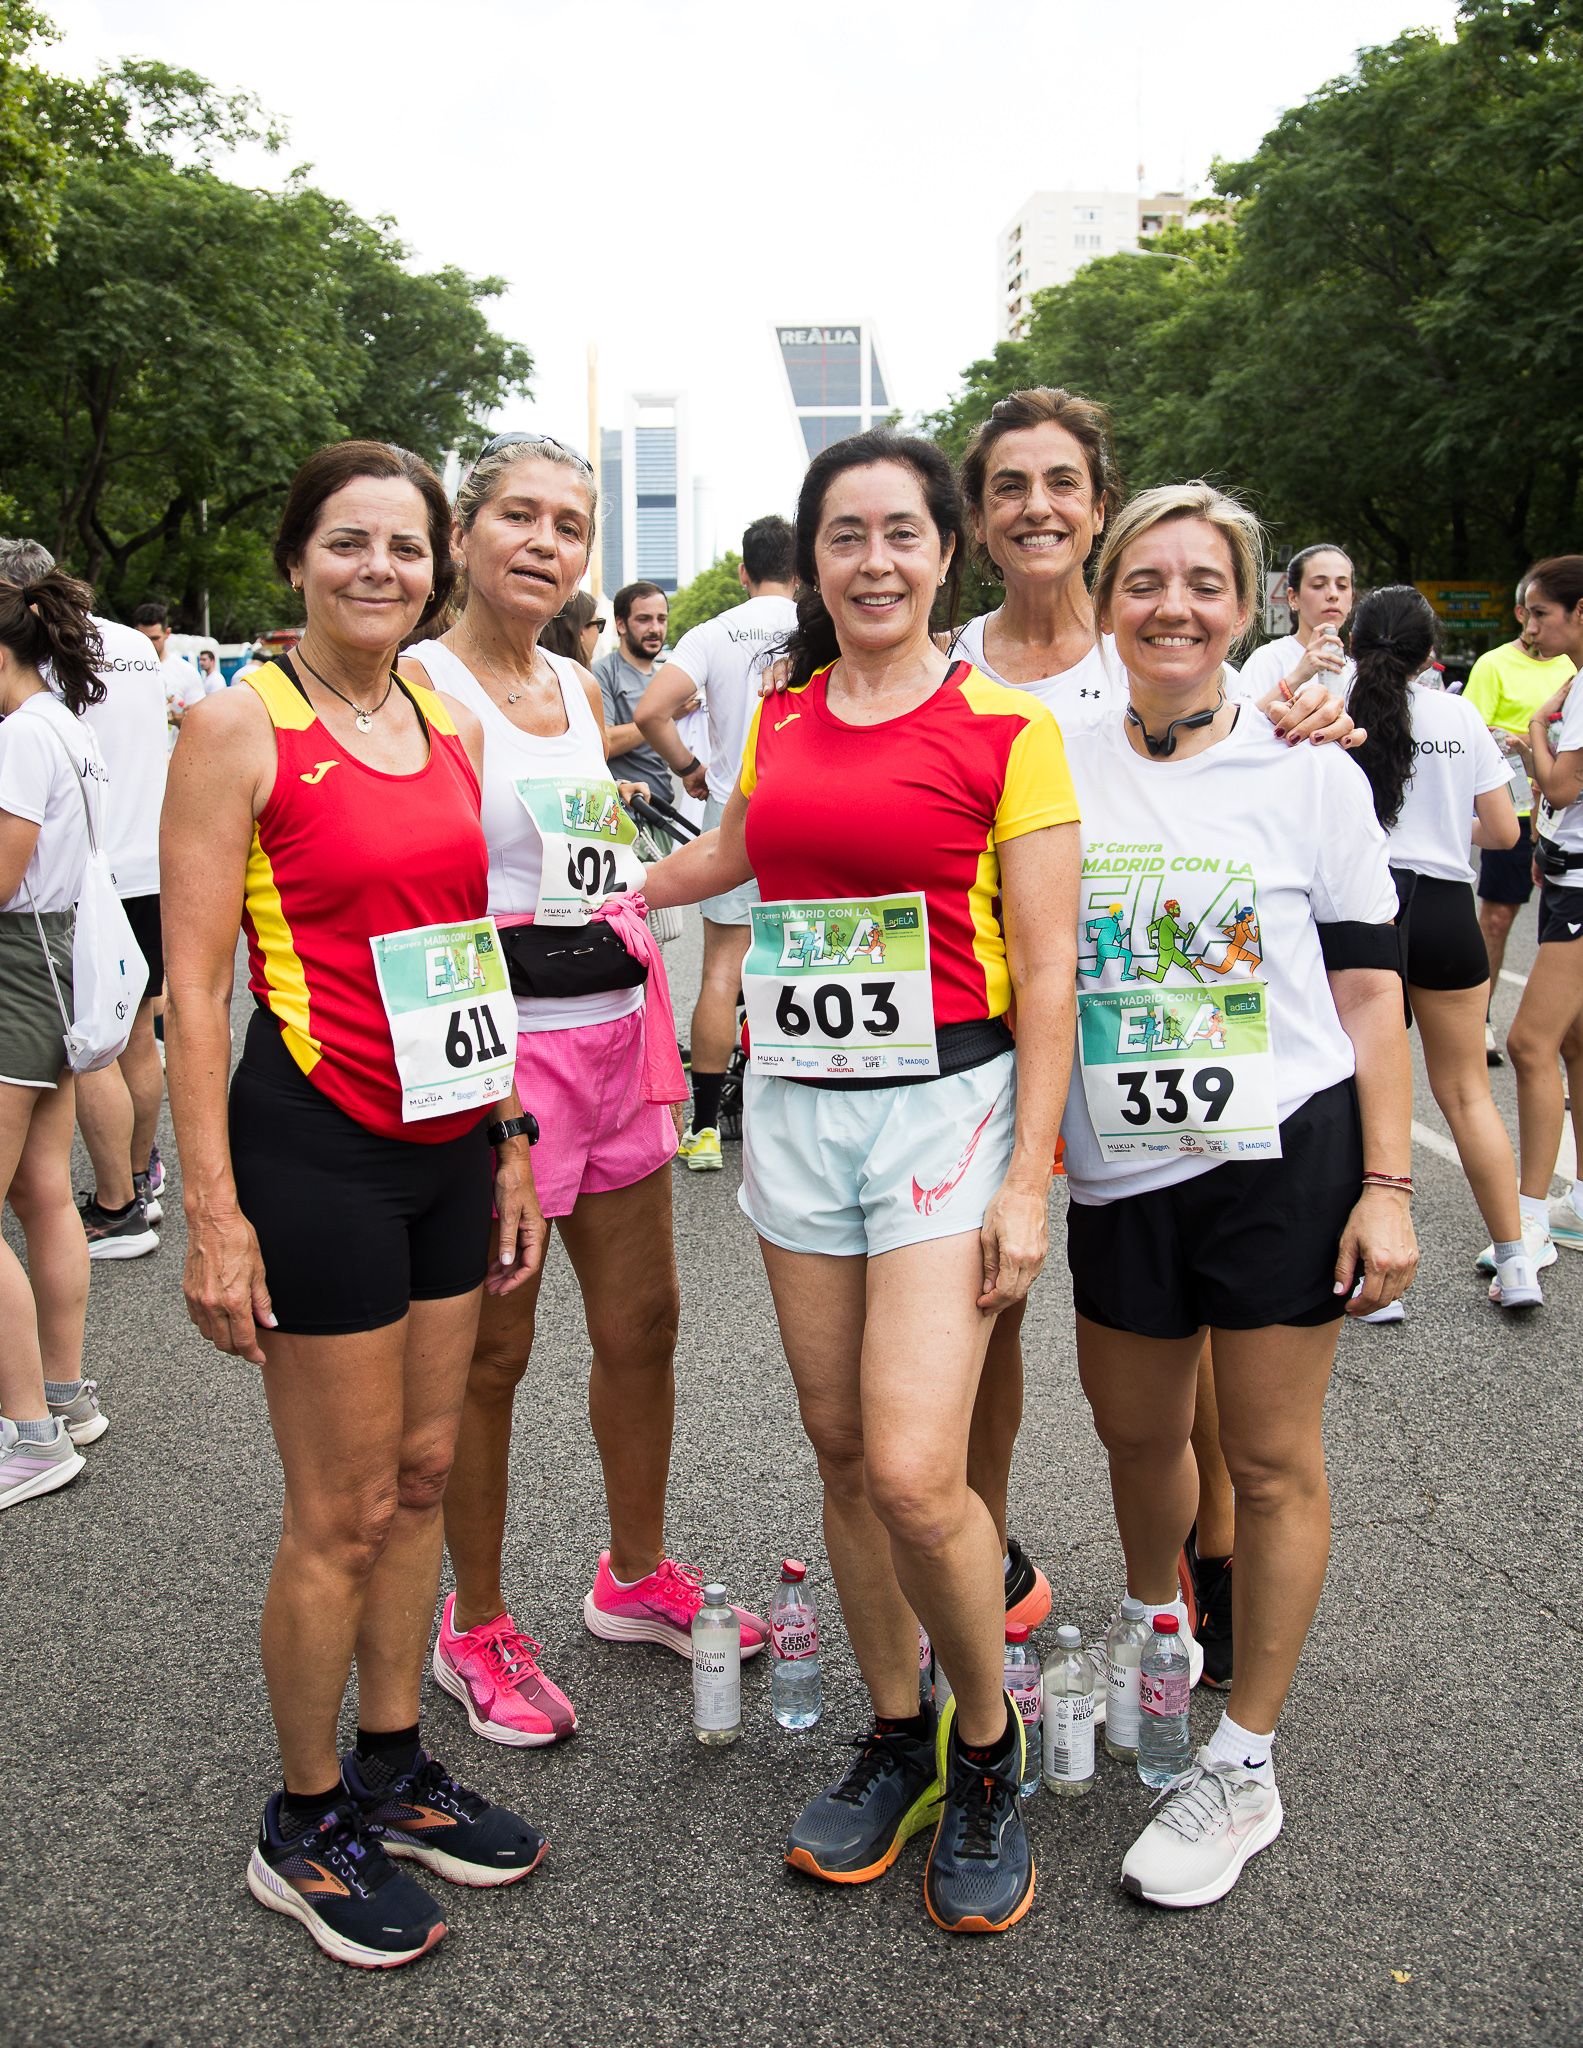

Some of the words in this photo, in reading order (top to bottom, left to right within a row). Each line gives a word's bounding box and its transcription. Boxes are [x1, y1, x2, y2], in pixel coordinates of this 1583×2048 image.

[557, 787, 622, 836] ELA
[1087, 842, 1103, 853] 3ª
[1106, 842, 1163, 853] Carrera
[1082, 857, 1166, 873] MADRID
[1170, 857, 1220, 873] CON
[1225, 860, 1253, 876] LA
[781, 908, 825, 920] MADRID
[828, 908, 853, 918] CON
[856, 907, 871, 917] LA
[1078, 874, 1263, 961] ELA
[777, 918, 884, 969] ELA
[425, 942, 486, 999] ELA
[1119, 994, 1163, 1006] MADRID
[1166, 993, 1195, 1003] CON
[1197, 993, 1213, 1002] LA
[776, 981, 900, 1039] 603
[1116, 1003, 1226, 1055] ELA
[445, 1004, 507, 1068] 611
[796, 1059, 819, 1068] Biogen
[904, 1057, 930, 1065] MADRID
[409, 1095, 443, 1106] MUKUA
[1117, 1066, 1234, 1126] 339
[781, 1634, 810, 1644] ZERO
[781, 1641, 811, 1651] SODIO
[696, 1648, 726, 1660] VITAMIN
[695, 1661, 725, 1673] RELOAD
[1108, 1675, 1125, 1688] OAD
[1016, 1697, 1037, 1709] ERO
[1072, 1695, 1094, 1707] VITA
[1019, 1705, 1037, 1716] DIO
[1072, 1704, 1090, 1714] WELL
[1072, 1708, 1094, 1721] RELO
[430, 1811, 451, 1823] BROOKS
[329, 1875, 346, 1892] BROOKS
